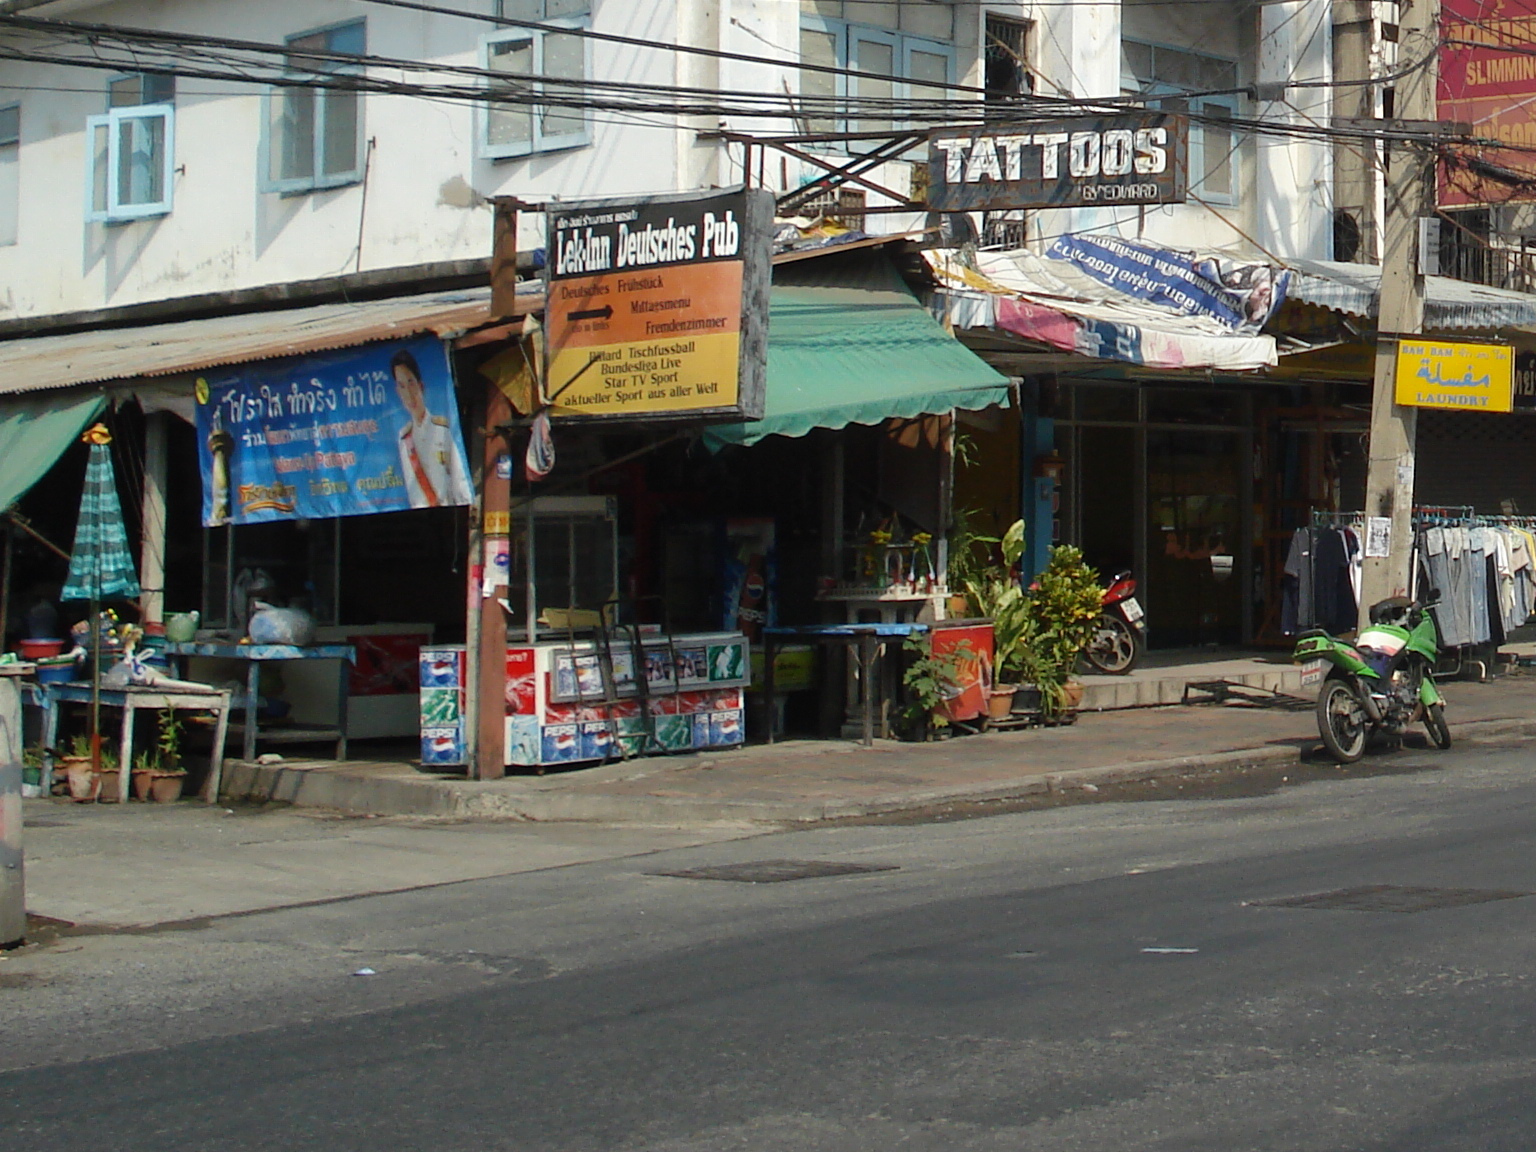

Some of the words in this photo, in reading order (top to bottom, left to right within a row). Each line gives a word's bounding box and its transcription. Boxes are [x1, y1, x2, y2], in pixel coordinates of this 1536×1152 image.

[933, 127, 1168, 184] TATTOOS
[617, 217, 696, 268] Deutsches
[702, 210, 739, 258] Pub
[562, 283, 610, 300] Deutsches
[645, 315, 728, 335] Fremdenzimmer
[628, 341, 696, 360] Tischfussball
[600, 361, 658, 376] Bundesliga
[660, 356, 682, 369] Live
[604, 377, 626, 390] Star
[632, 374, 647, 387] TV
[651, 371, 679, 387] Sport
[564, 392, 612, 407] aktueller
[615, 389, 643, 404] Sport
[648, 387, 666, 400] aus
[669, 384, 692, 397] aller
[696, 381, 719, 395] Welt
[1416, 392, 1490, 407] LAUNDRY
[420, 651, 455, 662] PEPSI
[421, 727, 456, 739] PEPSI
[544, 724, 578, 736] PEPSI
